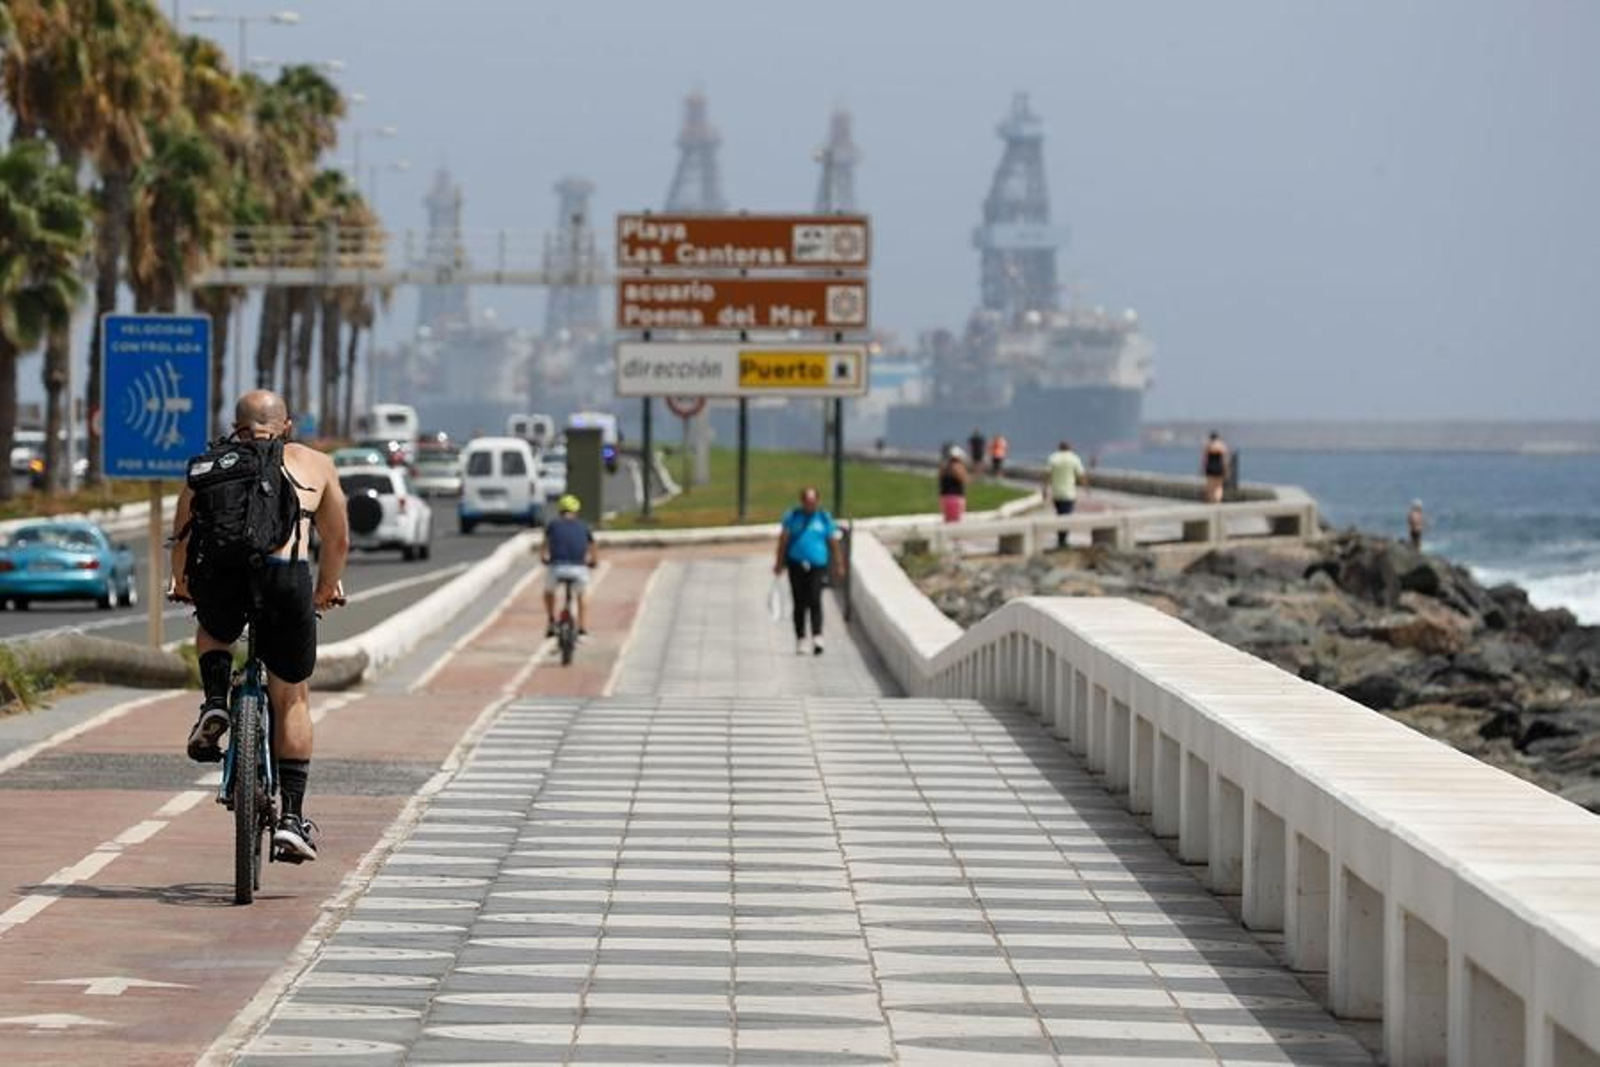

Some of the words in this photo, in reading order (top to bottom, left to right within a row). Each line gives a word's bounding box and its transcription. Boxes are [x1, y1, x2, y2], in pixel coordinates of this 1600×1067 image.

[622, 219, 687, 242] Playa
[622, 244, 662, 263] Las
[676, 244, 787, 264] Canteras
[624, 280, 715, 302] acuario
[624, 306, 704, 325] Poema
[717, 305, 757, 325] del
[769, 306, 817, 325] Mar
[120, 324, 194, 336] VELOCIDAD
[111, 341, 202, 353] CONTROLADA
[623, 355, 722, 379] dirección
[740, 359, 825, 379] Puerto
